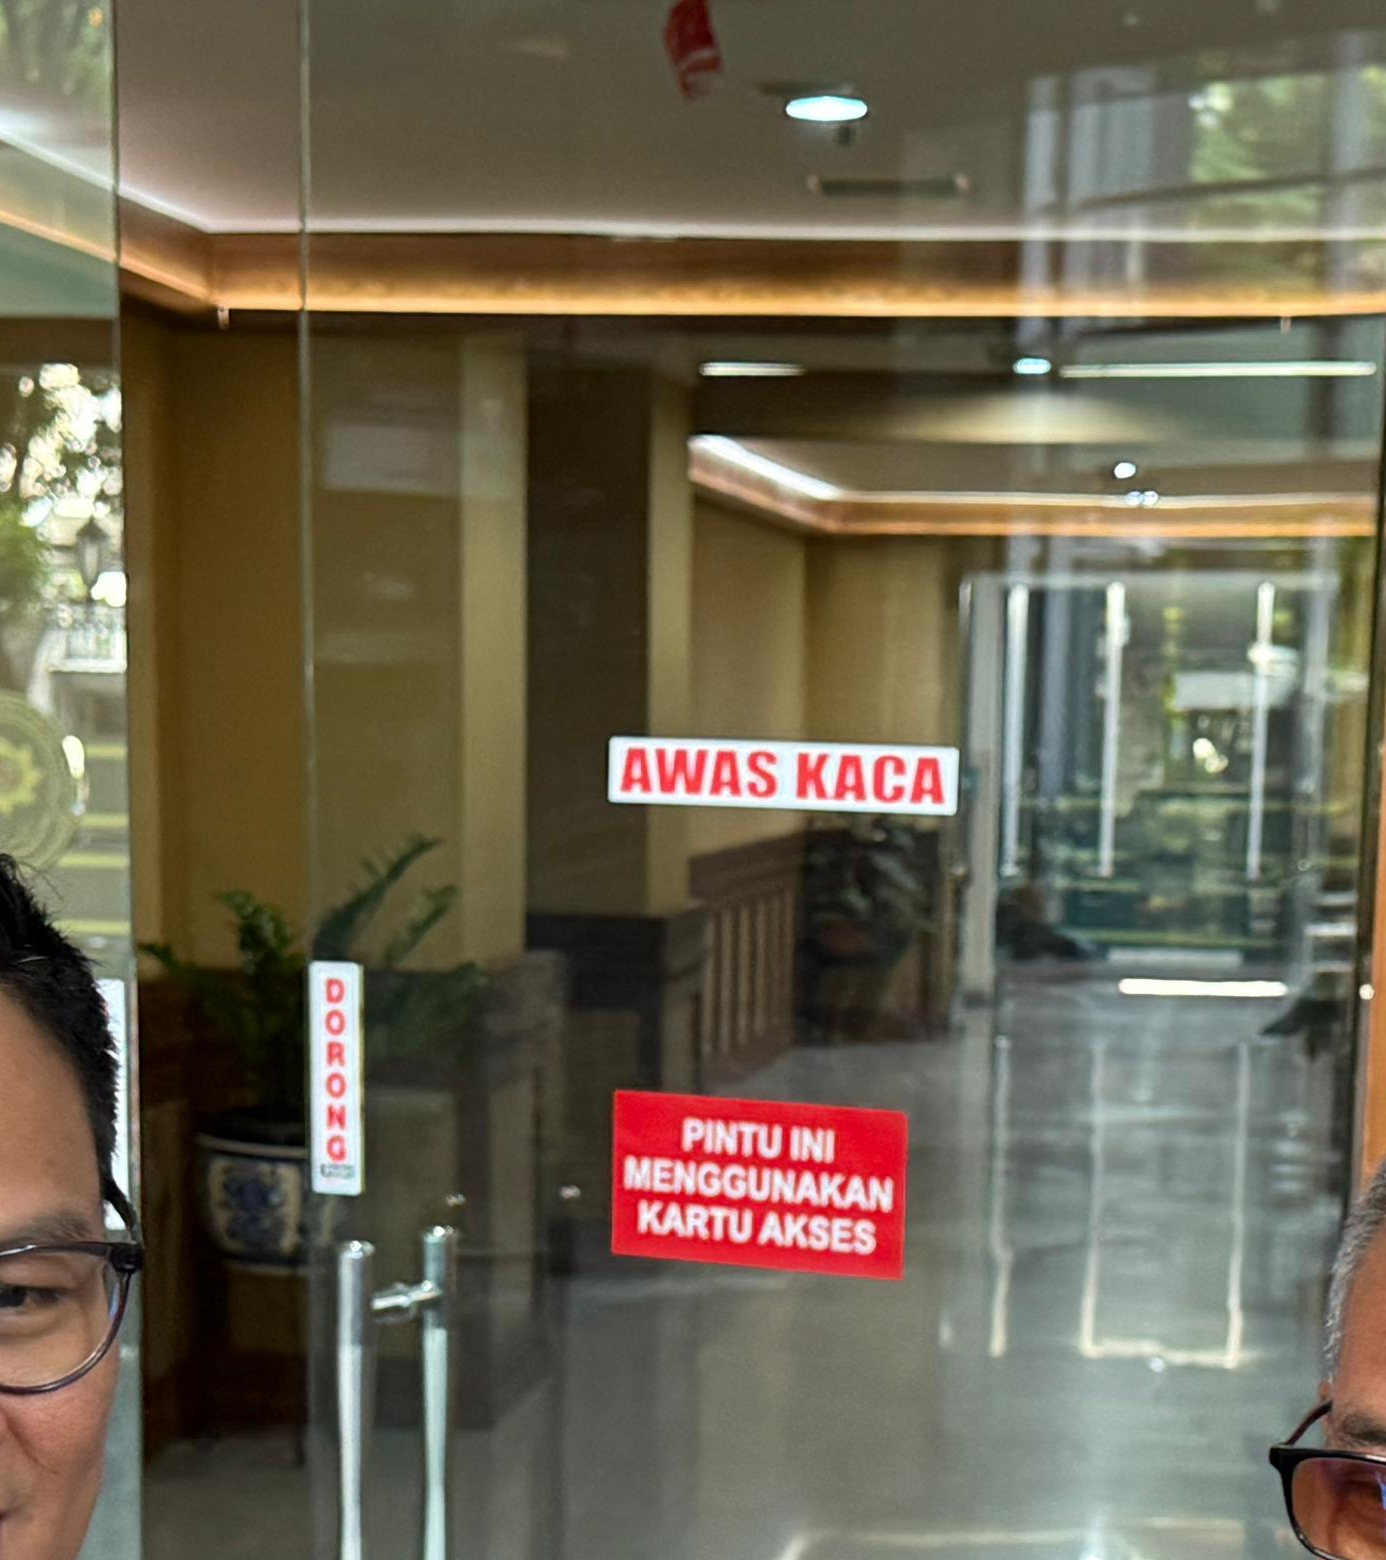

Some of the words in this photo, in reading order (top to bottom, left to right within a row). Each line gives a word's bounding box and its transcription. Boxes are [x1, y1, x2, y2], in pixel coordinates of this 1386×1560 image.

[621, 747, 779, 799] AWAS
[795, 752, 947, 805] KACA
[325, 977, 347, 1162] DORONG
[681, 1116, 782, 1160] PINTU
[789, 1126, 836, 1164] INI
[622, 1154, 895, 1213] MENGGUNAKAN
[635, 1198, 754, 1244] KARTU
[756, 1212, 878, 1256] AKSES
